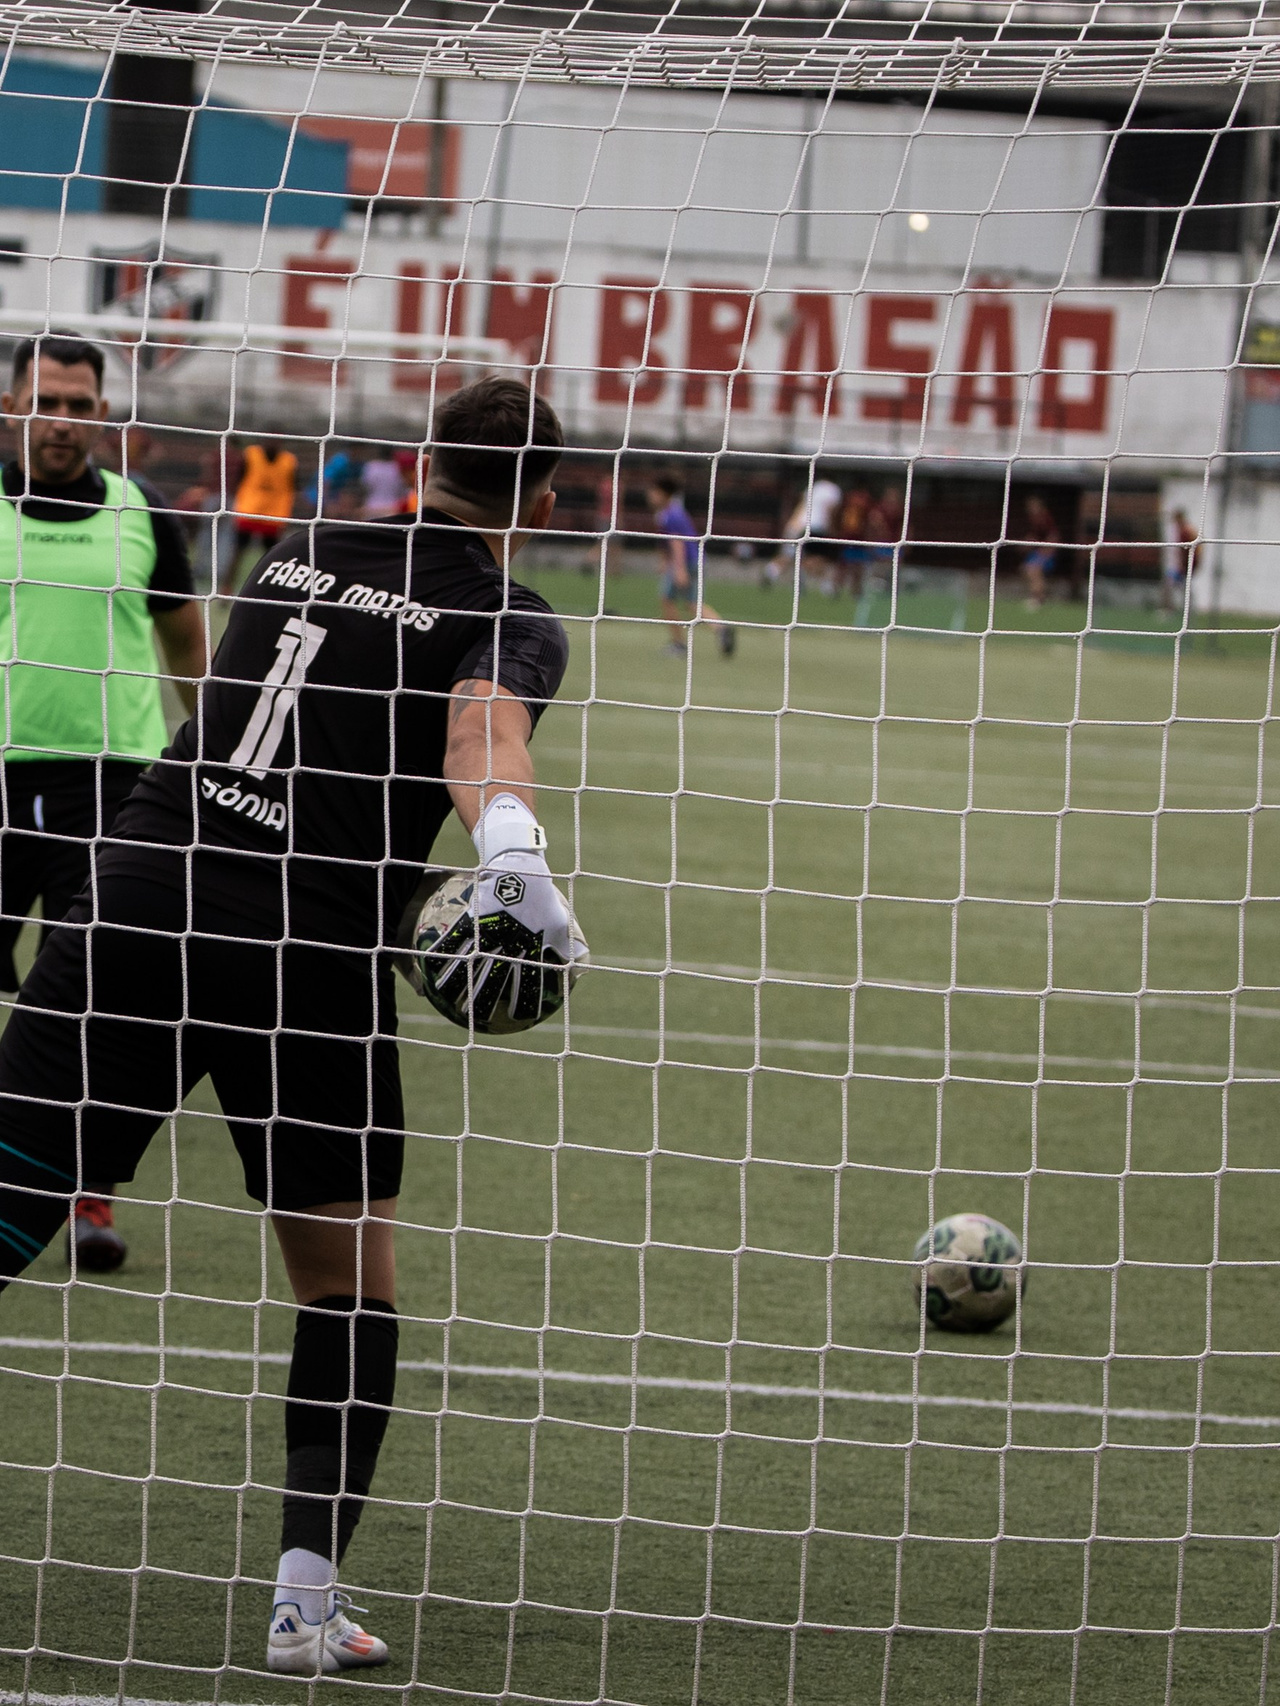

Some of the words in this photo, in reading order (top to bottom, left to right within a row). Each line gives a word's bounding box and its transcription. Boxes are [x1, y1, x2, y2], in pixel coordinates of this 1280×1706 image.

[594, 275, 1115, 434] BRASÃO
[23, 531, 94, 544] macron
[257, 557, 336, 595] FÁBIO
[337, 583, 441, 632] MATOS
[201, 777, 287, 832] SÓNIA
